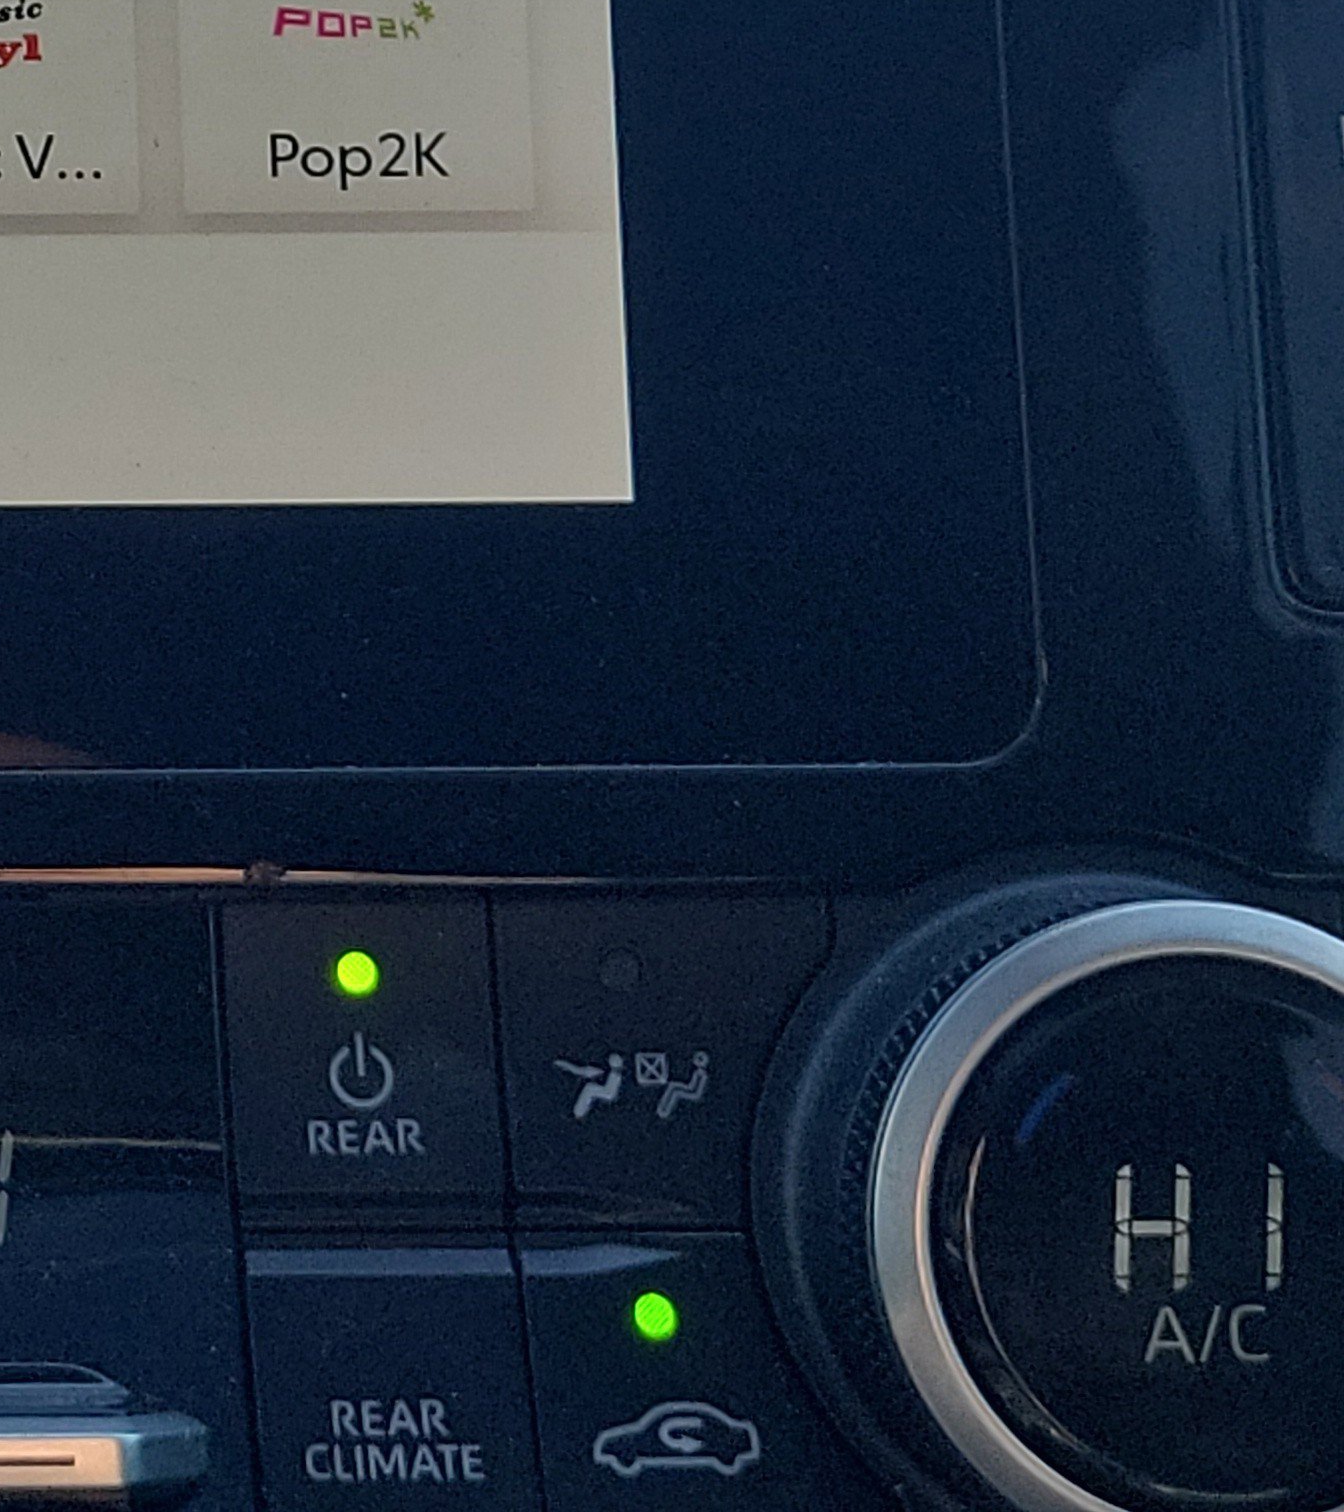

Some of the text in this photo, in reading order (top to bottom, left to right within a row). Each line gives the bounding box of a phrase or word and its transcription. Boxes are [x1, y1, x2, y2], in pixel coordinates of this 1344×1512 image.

[269, 132, 449, 191] Pop2K
[307, 1118, 425, 1155] REAR
[1144, 1304, 1270, 1364] A/C
[330, 1399, 449, 1438] REAR
[305, 1443, 485, 1481] CLIMATE
